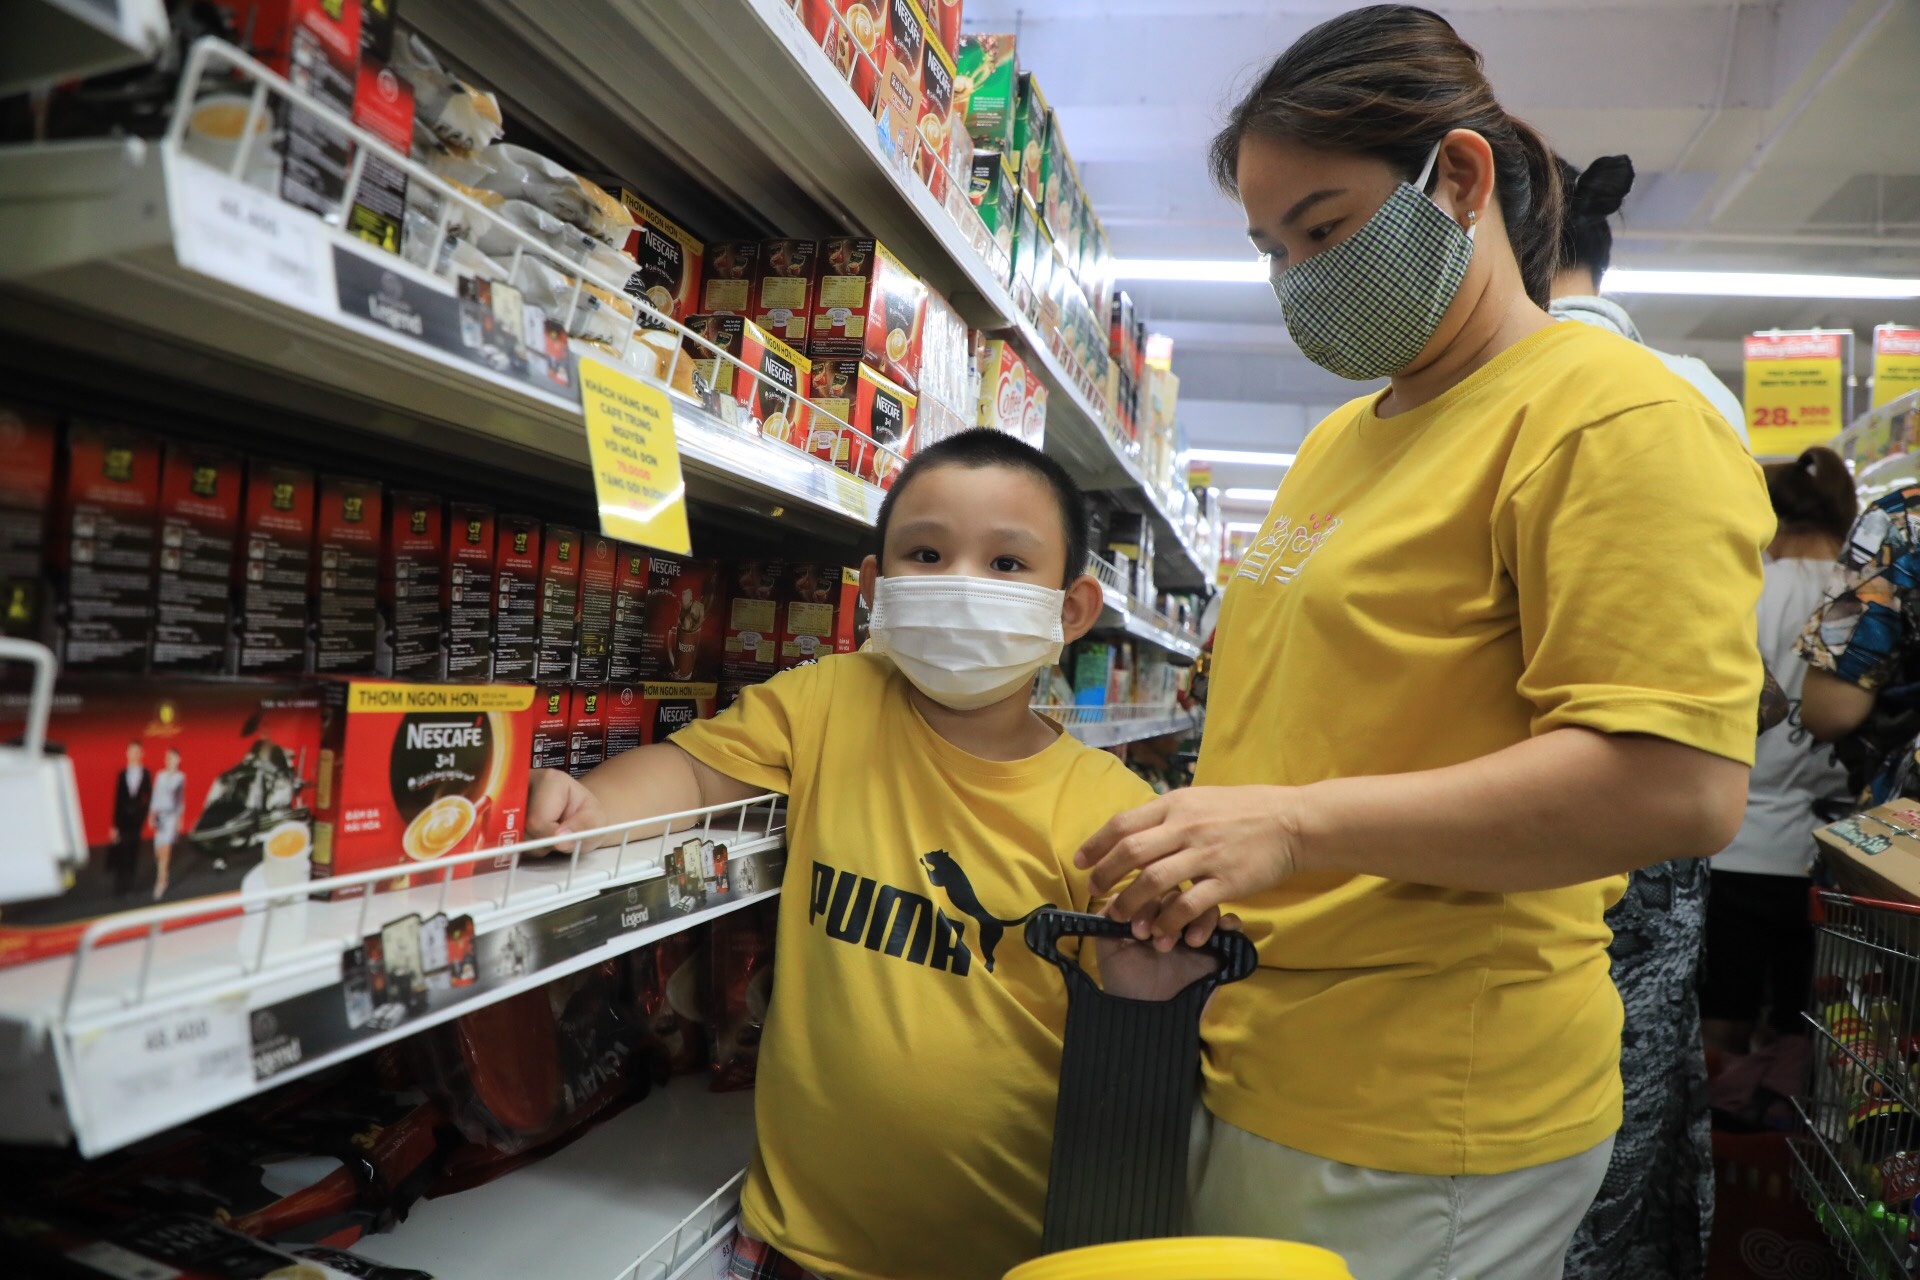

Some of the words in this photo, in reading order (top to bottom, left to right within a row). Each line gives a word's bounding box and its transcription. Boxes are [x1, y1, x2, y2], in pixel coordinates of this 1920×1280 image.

[359, 690, 402, 706] THƠM
[407, 691, 446, 706] NGON
[451, 691, 479, 706] HƠN
[660, 686, 678, 696] NGON
[621, 907, 649, 928] Legend
[809, 860, 971, 977] PUMA
